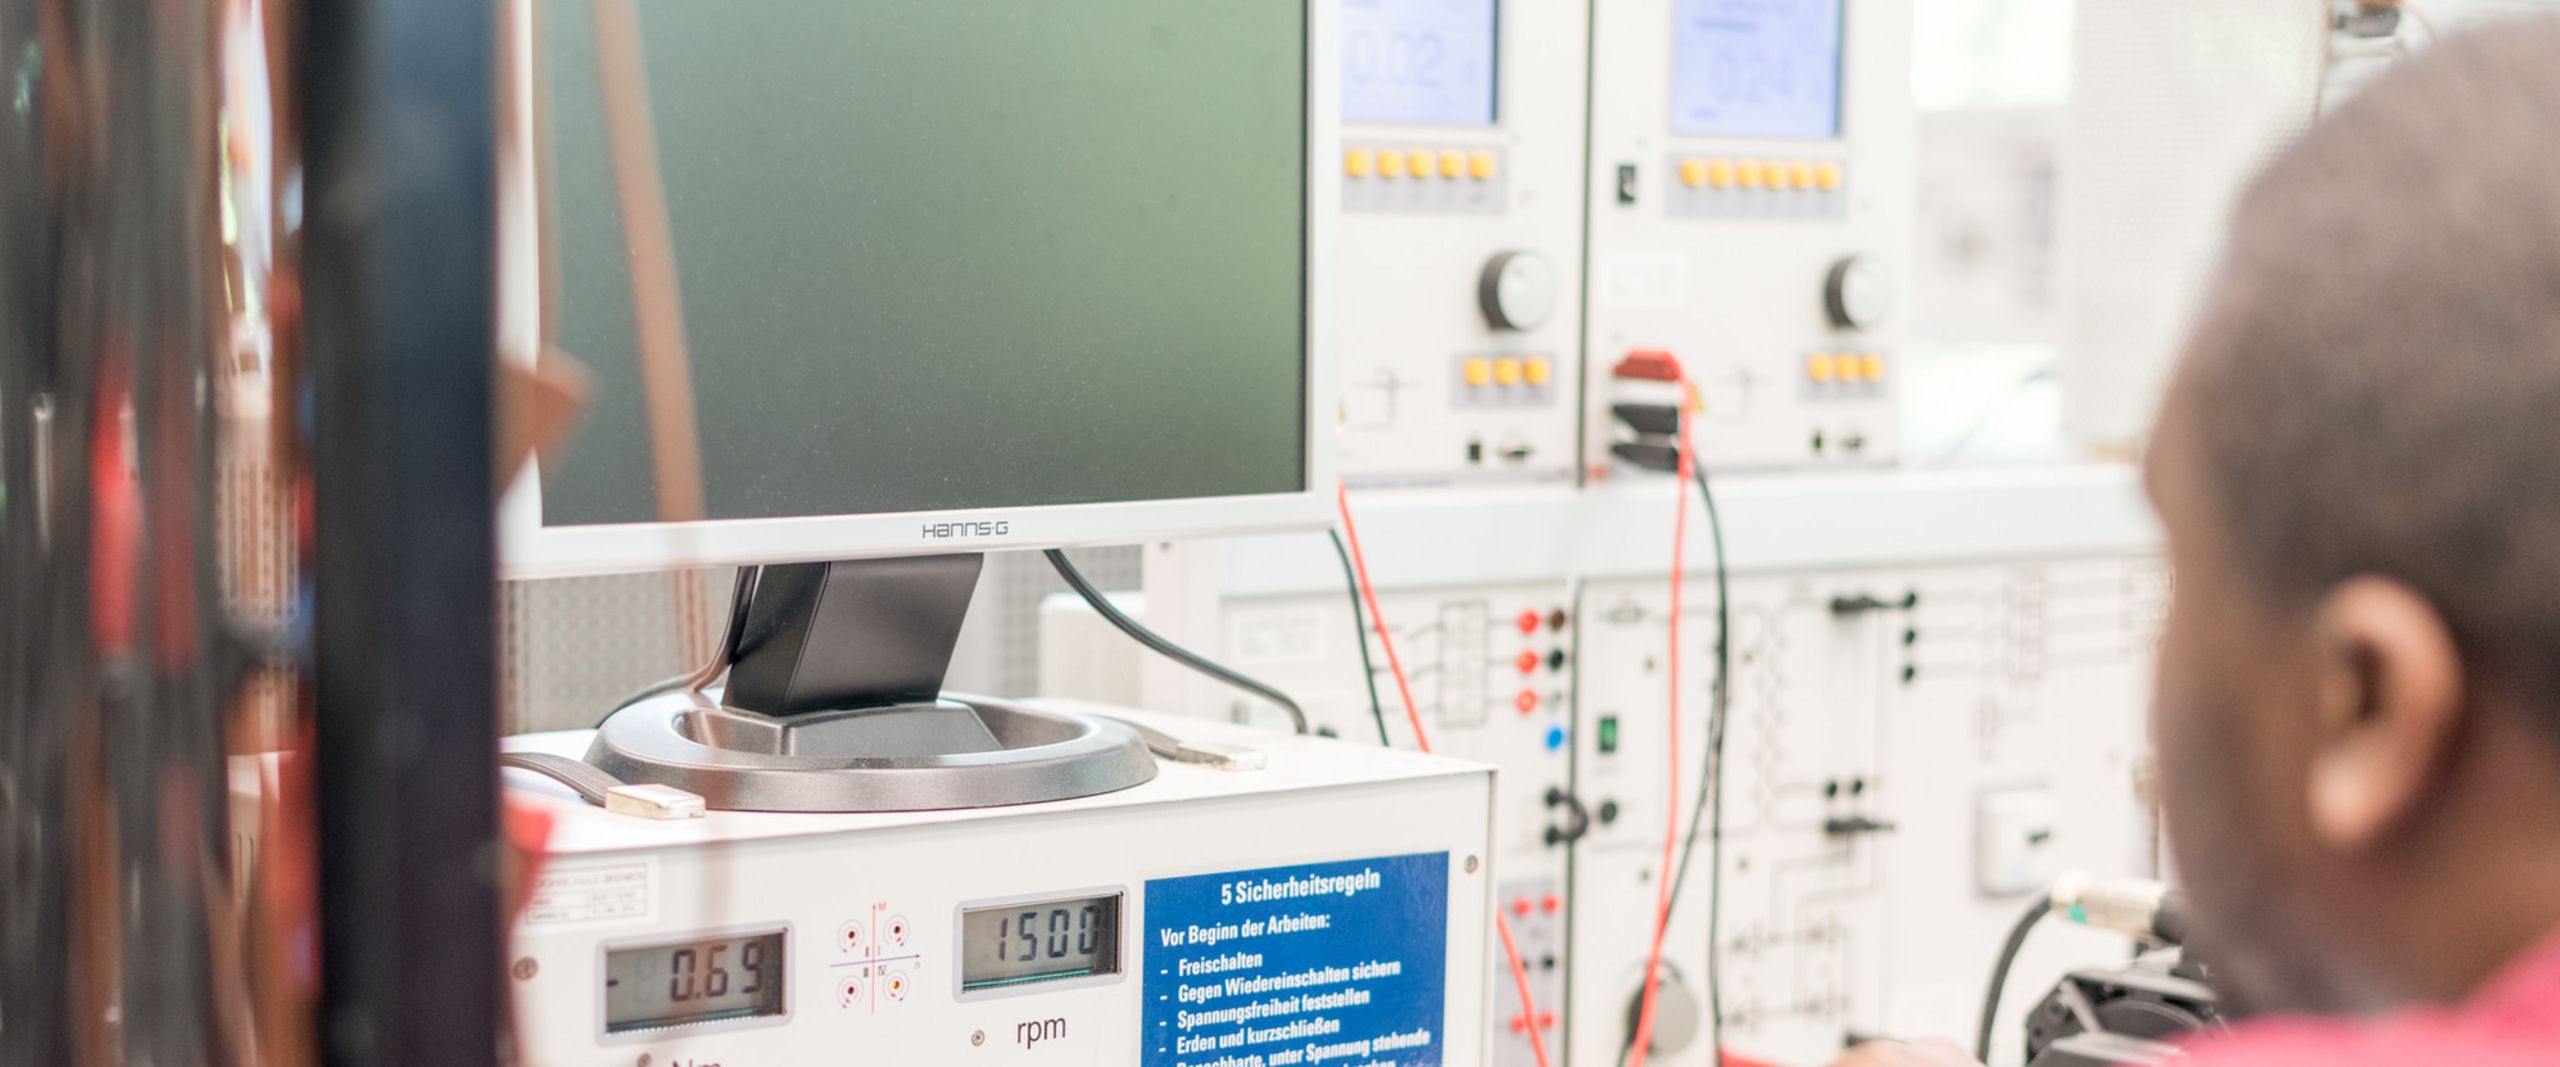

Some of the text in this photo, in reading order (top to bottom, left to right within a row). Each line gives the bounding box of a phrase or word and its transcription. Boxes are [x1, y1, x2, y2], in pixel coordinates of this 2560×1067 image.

[1221, 867, 1381, 905] 5 Sicherheitsregeln
[998, 905, 1099, 962] 1500
[1161, 912, 1331, 947] Vor Beginn der Arbeiten:
[1178, 984, 1222, 1004] Gegen
[1225, 966, 1350, 996] Wiedereinschalten
[1352, 959, 1401, 981] sichern
[1179, 951, 1263, 977] Freischalten
[1177, 996, 1299, 1032] Spannungsfreiheit
[1302, 987, 1371, 1012] feststellen
[1017, 1017, 1066, 1049] rpm
[1177, 1034, 1216, 1055] Erden
[1219, 1028, 1245, 1049] und
[1247, 1017, 1340, 1045] kurzschließen
[1269, 1048, 1304, 1066] unter
[1305, 1040, 1371, 1065] Spannung
[1372, 1027, 1431, 1052] stehende
